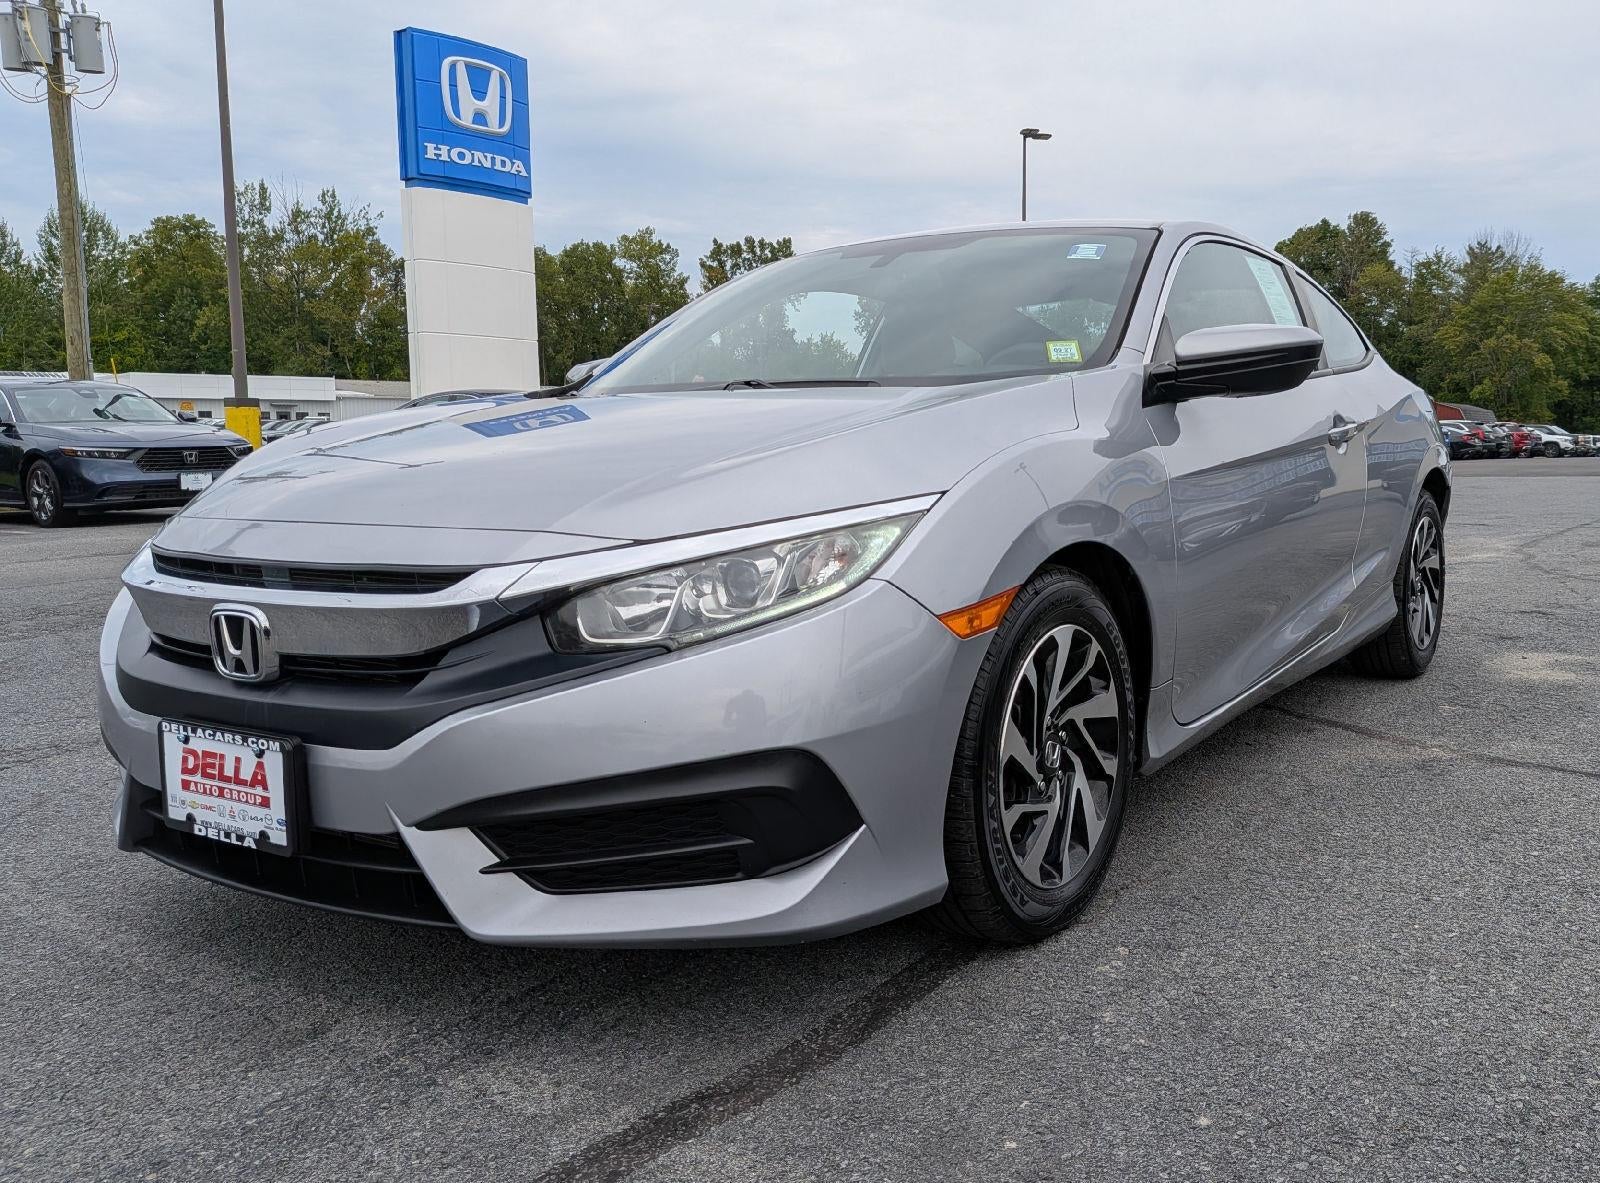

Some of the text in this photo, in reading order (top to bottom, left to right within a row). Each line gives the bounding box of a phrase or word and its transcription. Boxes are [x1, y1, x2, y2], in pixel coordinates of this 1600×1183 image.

[424, 142, 529, 177] HONDA
[162, 721, 281, 752] DELLACARS.COM
[180, 746, 269, 792] DELLA
[189, 782, 262, 805] AUTO GROUP
[193, 823, 257, 849] DELLA
